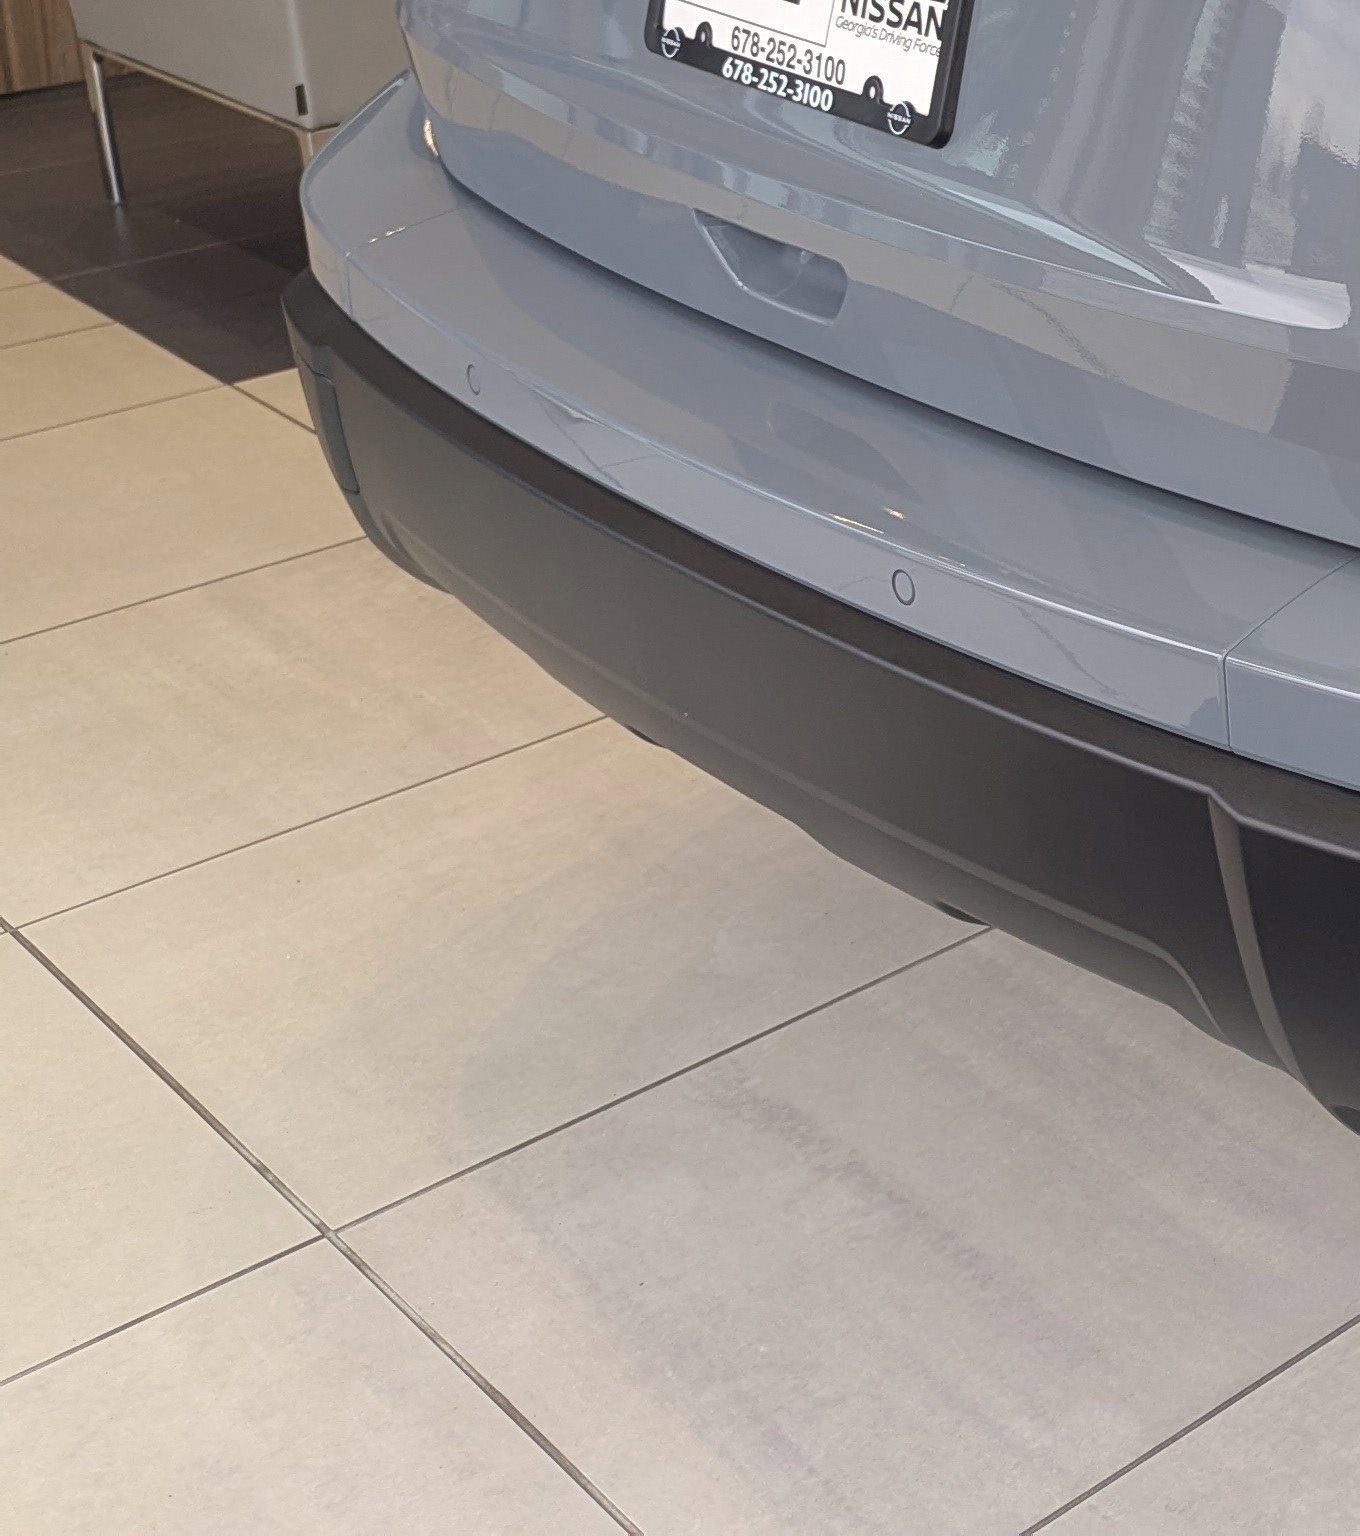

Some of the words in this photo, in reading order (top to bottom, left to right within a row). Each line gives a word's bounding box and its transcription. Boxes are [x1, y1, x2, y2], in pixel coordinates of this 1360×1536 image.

[730, 25, 847, 87] 678-252-3100
[835, 15, 879, 40] Georgia's
[878, 27, 912, 52] Driving
[912, 37, 941, 59] Force
[721, 56, 834, 113] 678-252-3100
